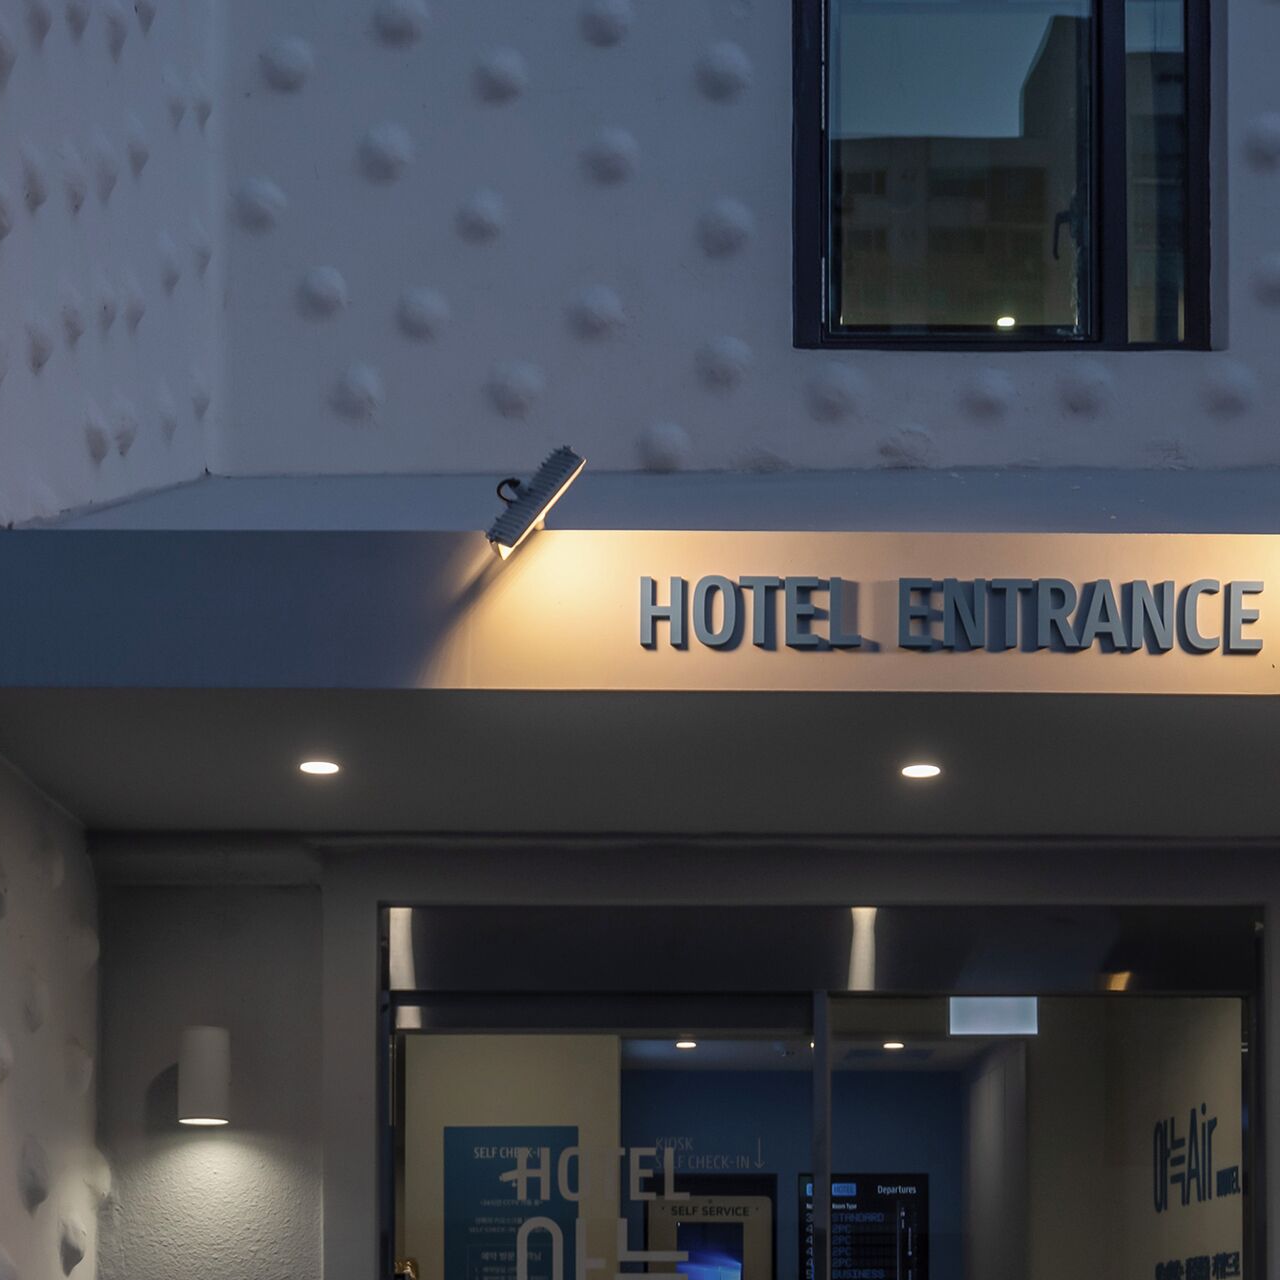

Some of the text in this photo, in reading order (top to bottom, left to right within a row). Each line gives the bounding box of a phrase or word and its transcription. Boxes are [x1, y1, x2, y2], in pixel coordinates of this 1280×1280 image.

[640, 575, 1265, 653] HOTEL ENTRANCE
[655, 1137, 693, 1151] KIOSK
[473, 1146, 497, 1159] SELF
[687, 1155, 750, 1169] CHECK-IN
[517, 1146, 690, 1201] HOTEL
[877, 1184, 917, 1196] Departures
[671, 1205, 749, 1216] SELF SERVICE
